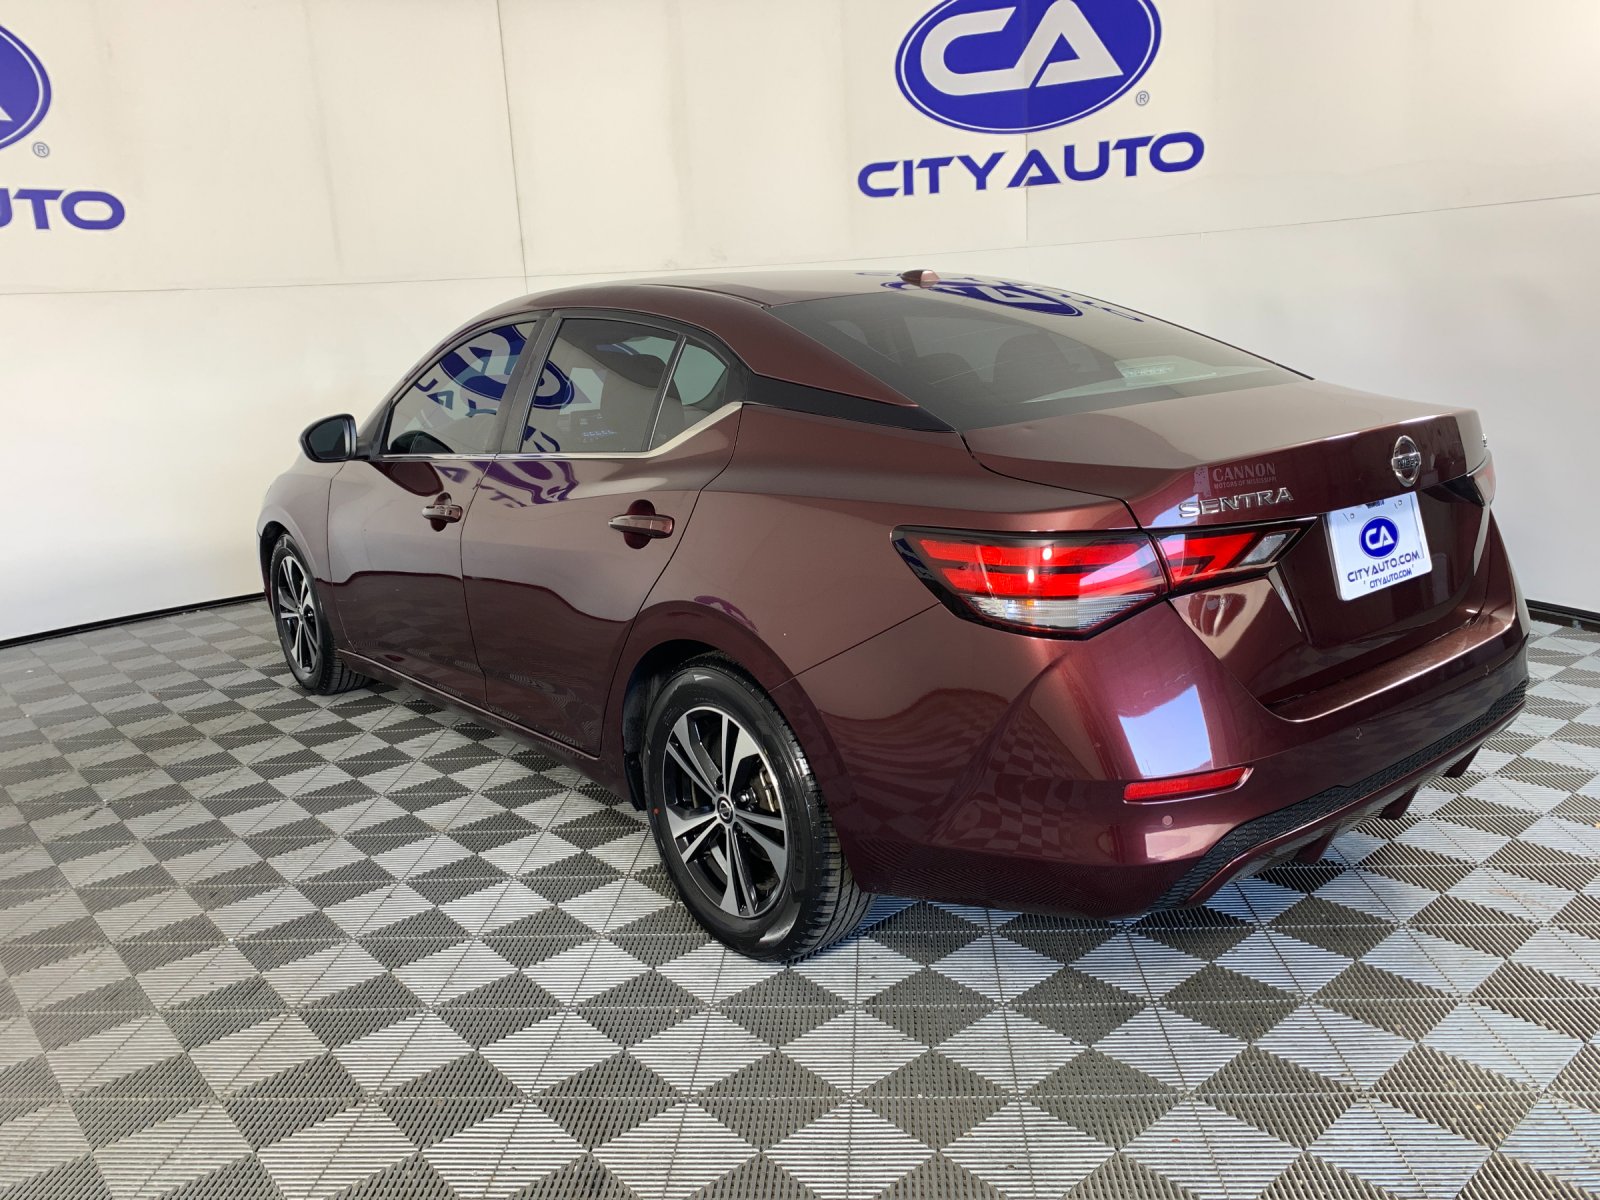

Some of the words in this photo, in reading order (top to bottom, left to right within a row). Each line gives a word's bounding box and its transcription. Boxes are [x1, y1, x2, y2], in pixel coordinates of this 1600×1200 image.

[920, 0, 1124, 96] CA
[0, 188, 125, 230] TO
[1212, 462, 1276, 482] CANNON
[1213, 480, 1237, 490] MOTORS
[1178, 486, 1294, 518] SENTRA
[1347, 550, 1420, 582] CITYAUTO.COM
[1369, 567, 1413, 588] CITYAUTO.COM
